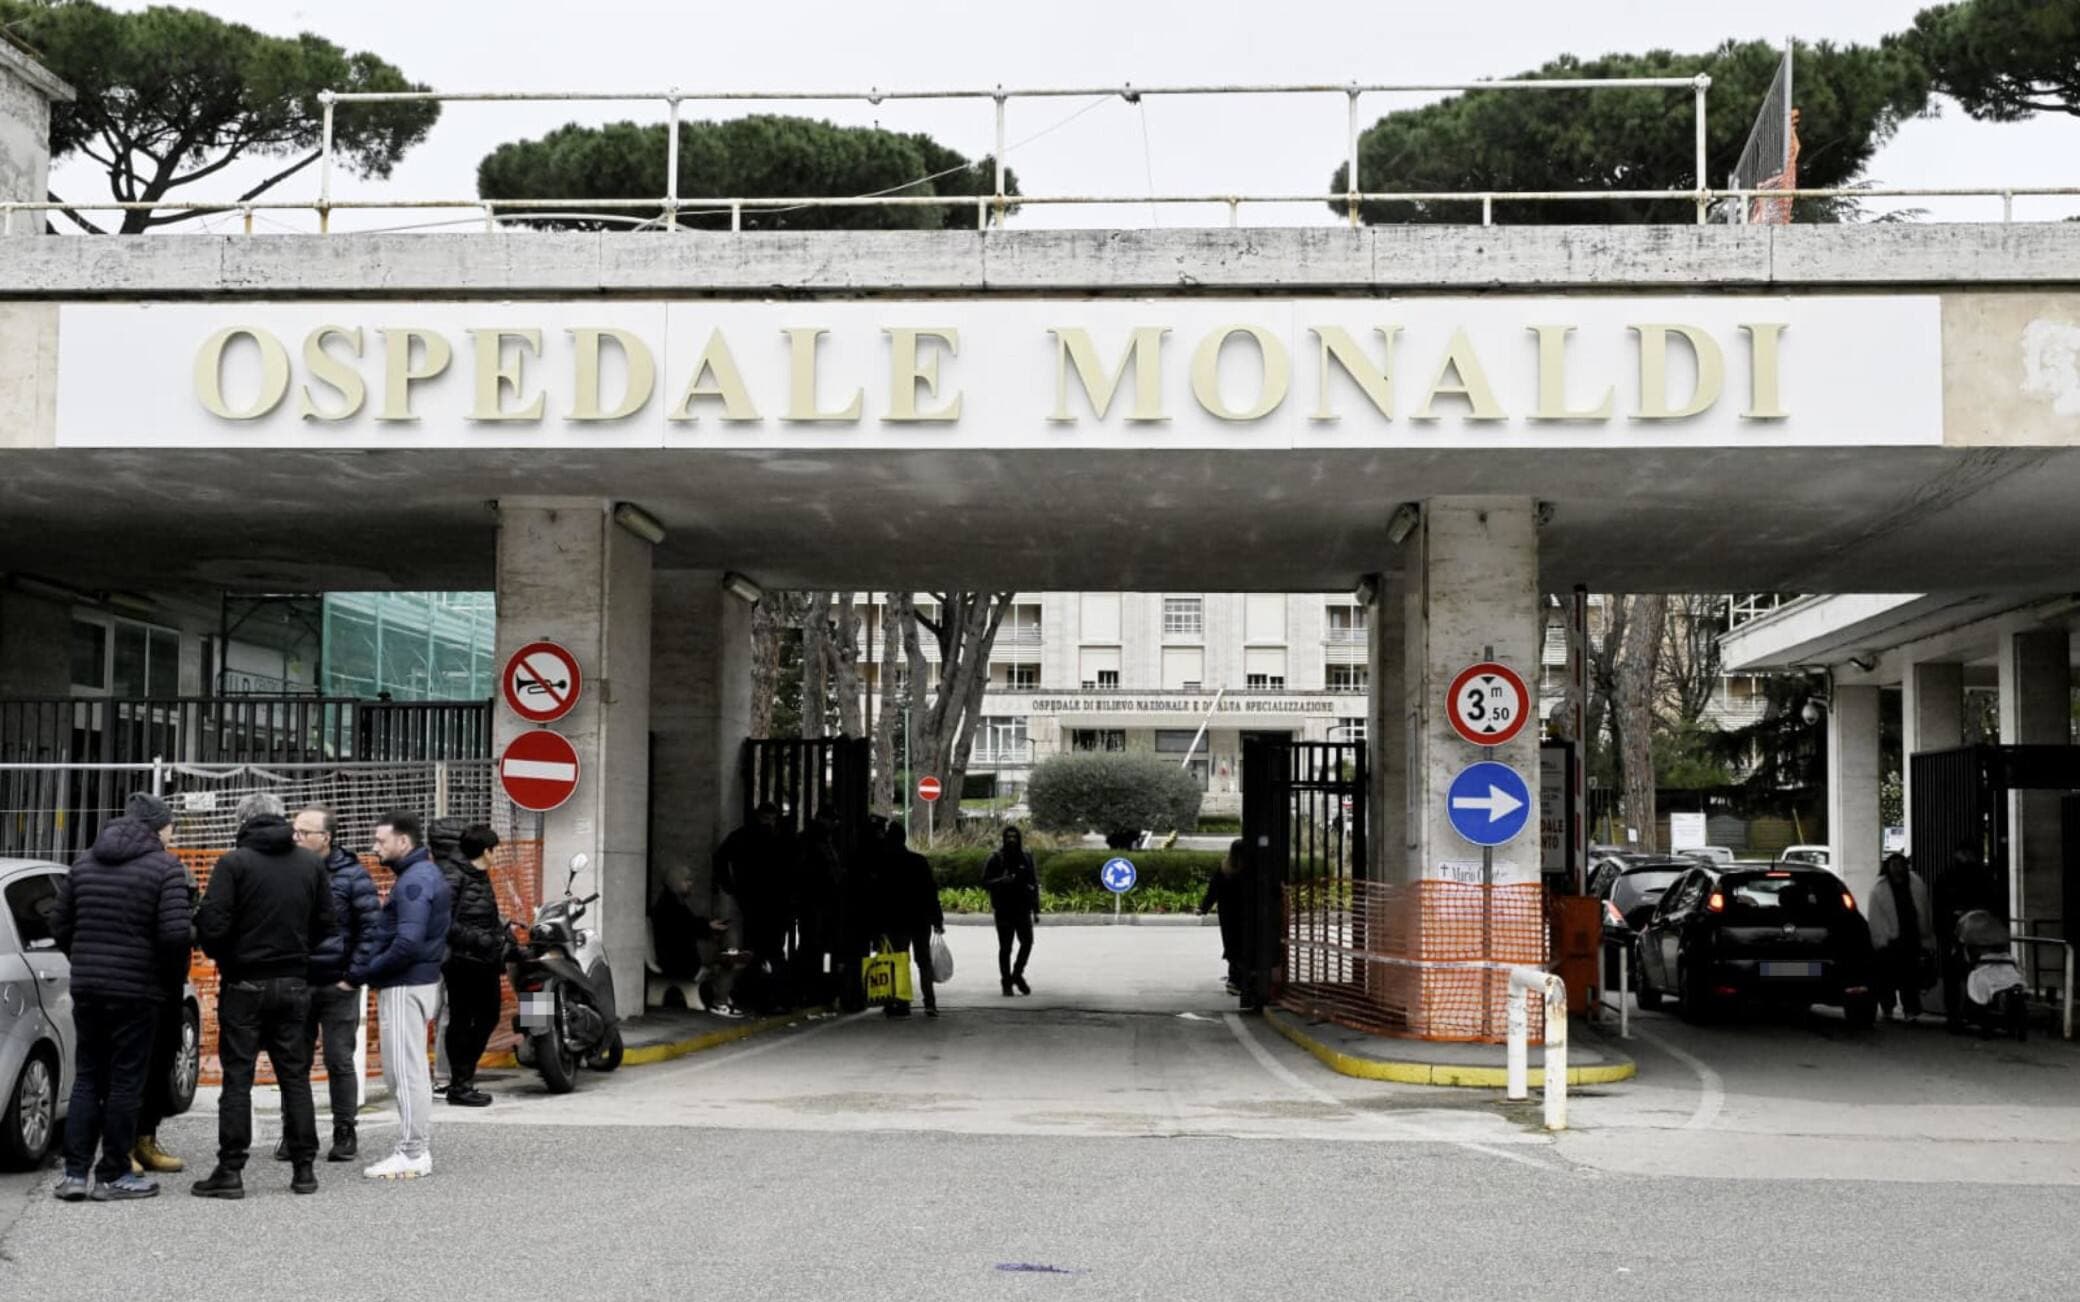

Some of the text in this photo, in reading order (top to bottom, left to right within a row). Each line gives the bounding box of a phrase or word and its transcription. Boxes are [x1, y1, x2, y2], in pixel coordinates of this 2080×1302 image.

[194, 321, 1790, 424] OSPEDALE MONALDI
[1032, 700, 1080, 712] OSPEDALE
[1083, 700, 1094, 712] DI
[1096, 700, 1134, 712] RILIEVO
[1136, 700, 1189, 712] NAZIONALE
[1193, 700, 1199, 712] E
[1216, 700, 1241, 712] ALTA
[1245, 701, 1334, 713] SPECIALIZZAZIONE
